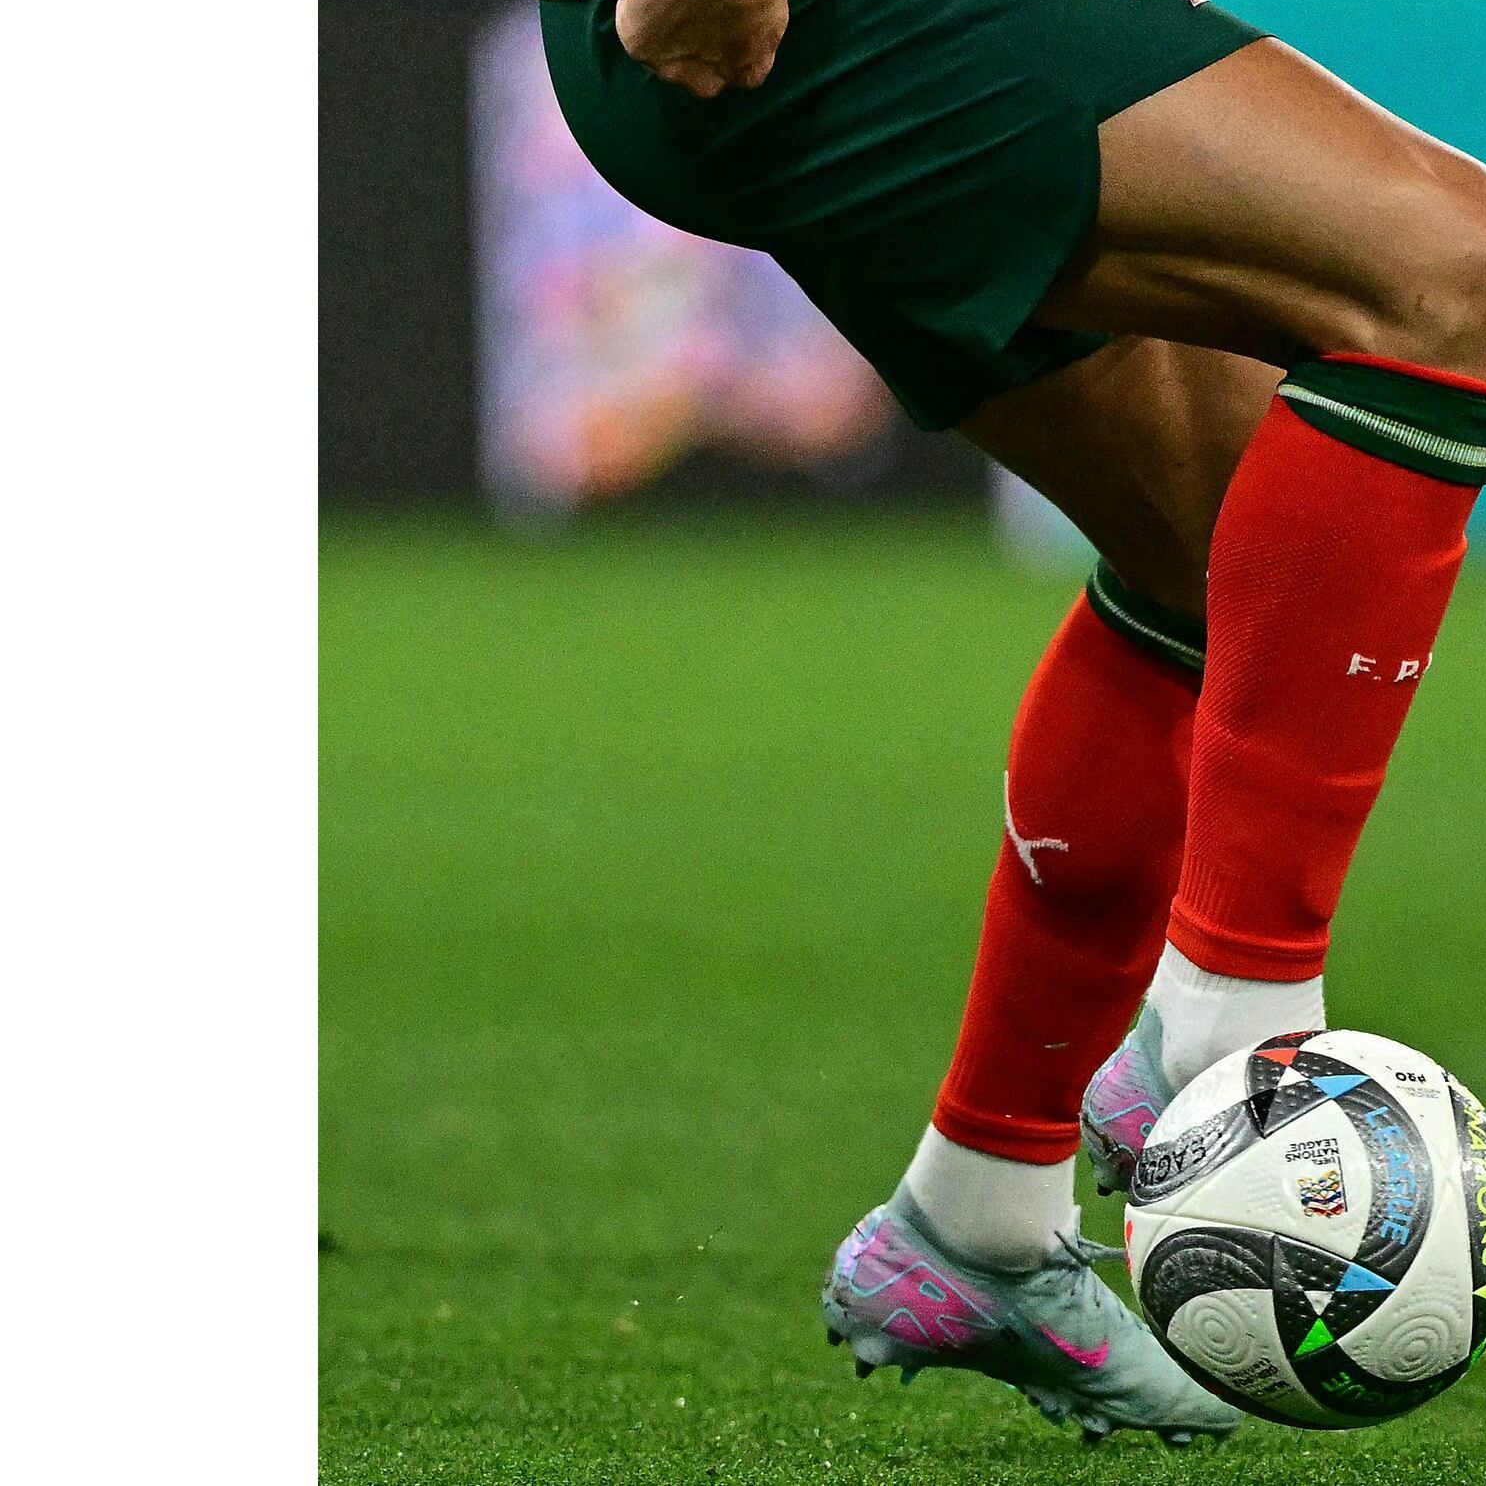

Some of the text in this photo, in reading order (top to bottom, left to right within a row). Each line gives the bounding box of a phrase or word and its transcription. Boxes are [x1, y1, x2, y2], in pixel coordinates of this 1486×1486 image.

[1286, 1138, 1338, 1152] LEAGUE
[1285, 1147, 1340, 1163] NATIONS
[1365, 1106, 1417, 1245] LEAGUE
